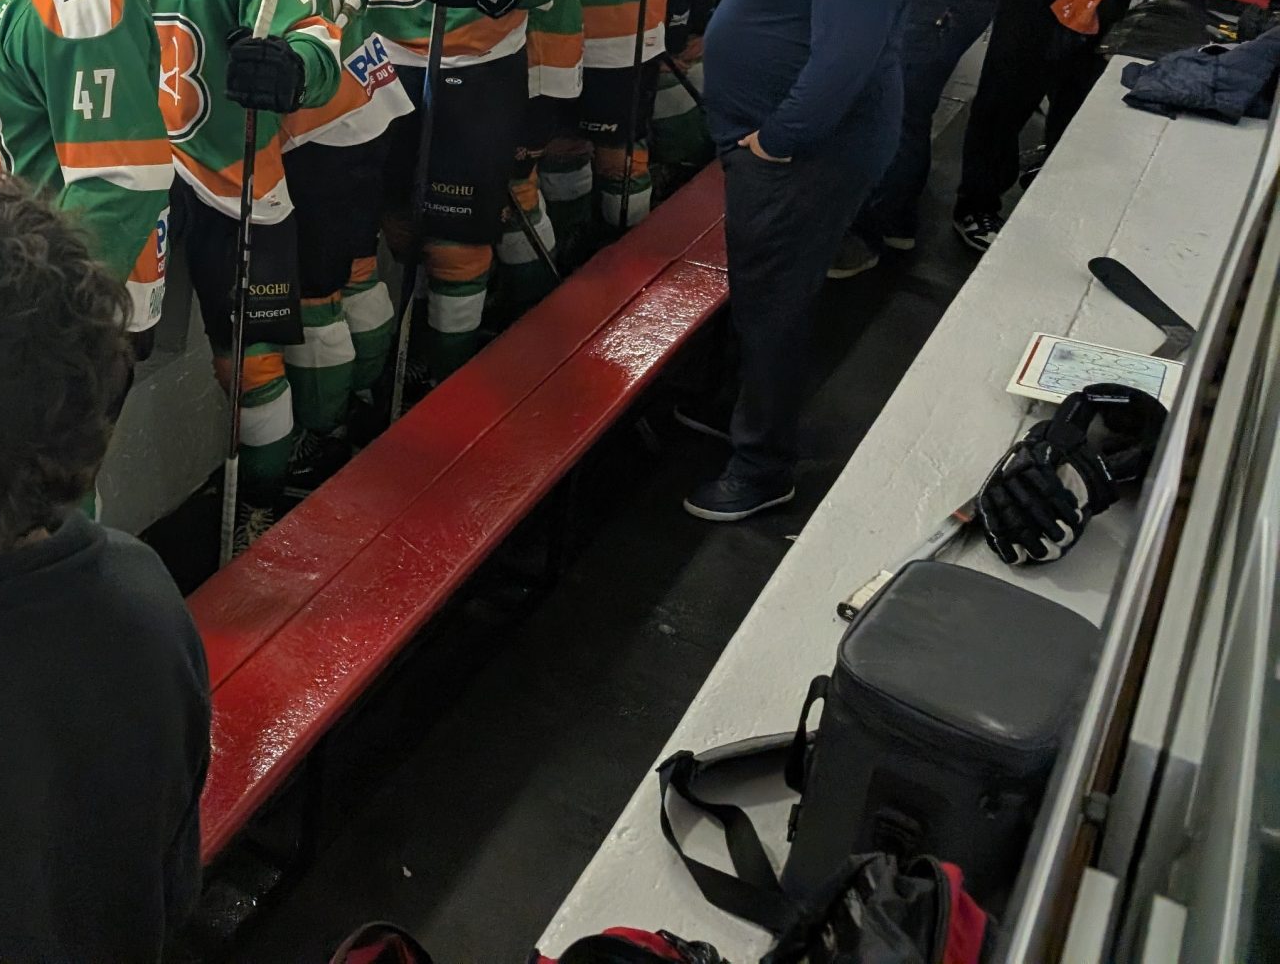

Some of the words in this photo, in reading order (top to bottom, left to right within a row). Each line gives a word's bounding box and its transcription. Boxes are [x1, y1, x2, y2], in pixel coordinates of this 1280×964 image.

[73, 68, 116, 120] 47
[577, 119, 619, 133] CCM
[431, 181, 475, 197] SOGHU
[248, 283, 291, 296] SOGHU
